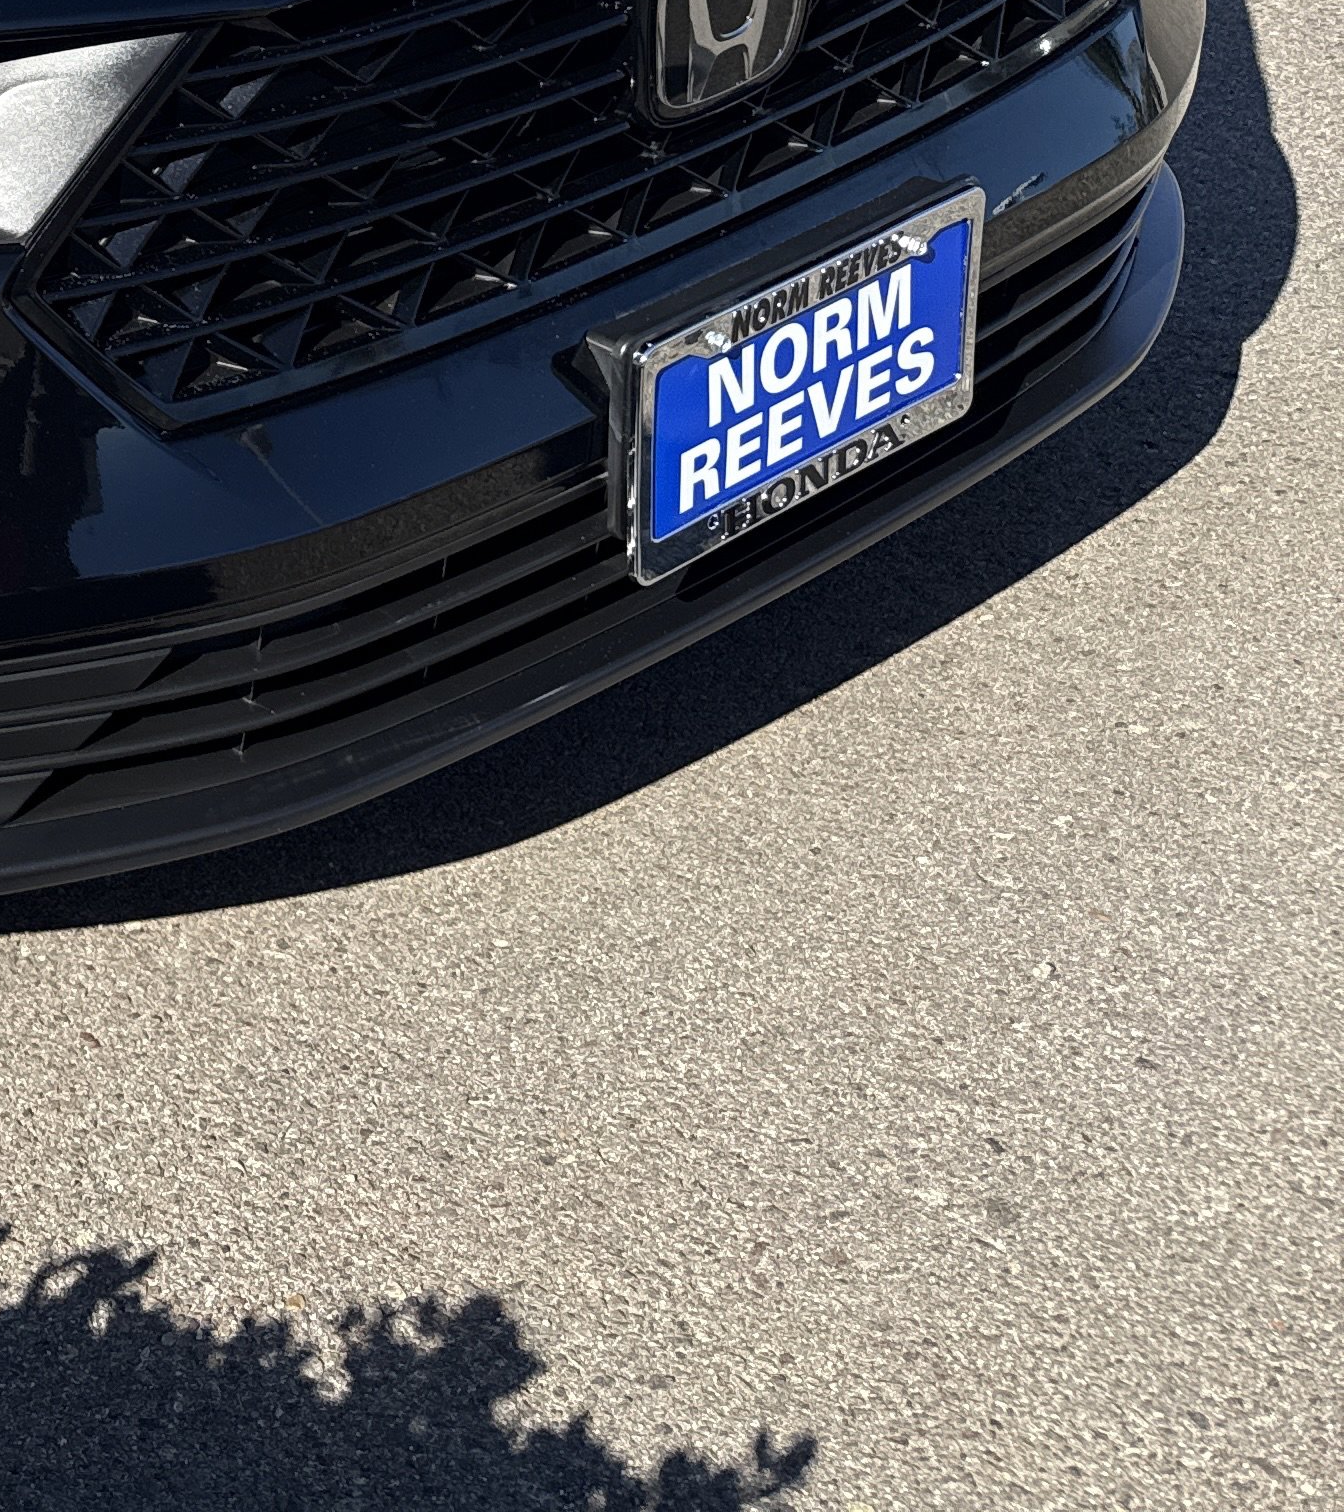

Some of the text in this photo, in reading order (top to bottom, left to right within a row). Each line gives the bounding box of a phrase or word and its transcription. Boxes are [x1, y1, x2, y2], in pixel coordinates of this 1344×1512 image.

[708, 263, 912, 428] NORM
[731, 231, 904, 343] NORM REEVES
[678, 326, 936, 515] REEVES
[720, 420, 907, 540] HONDA
